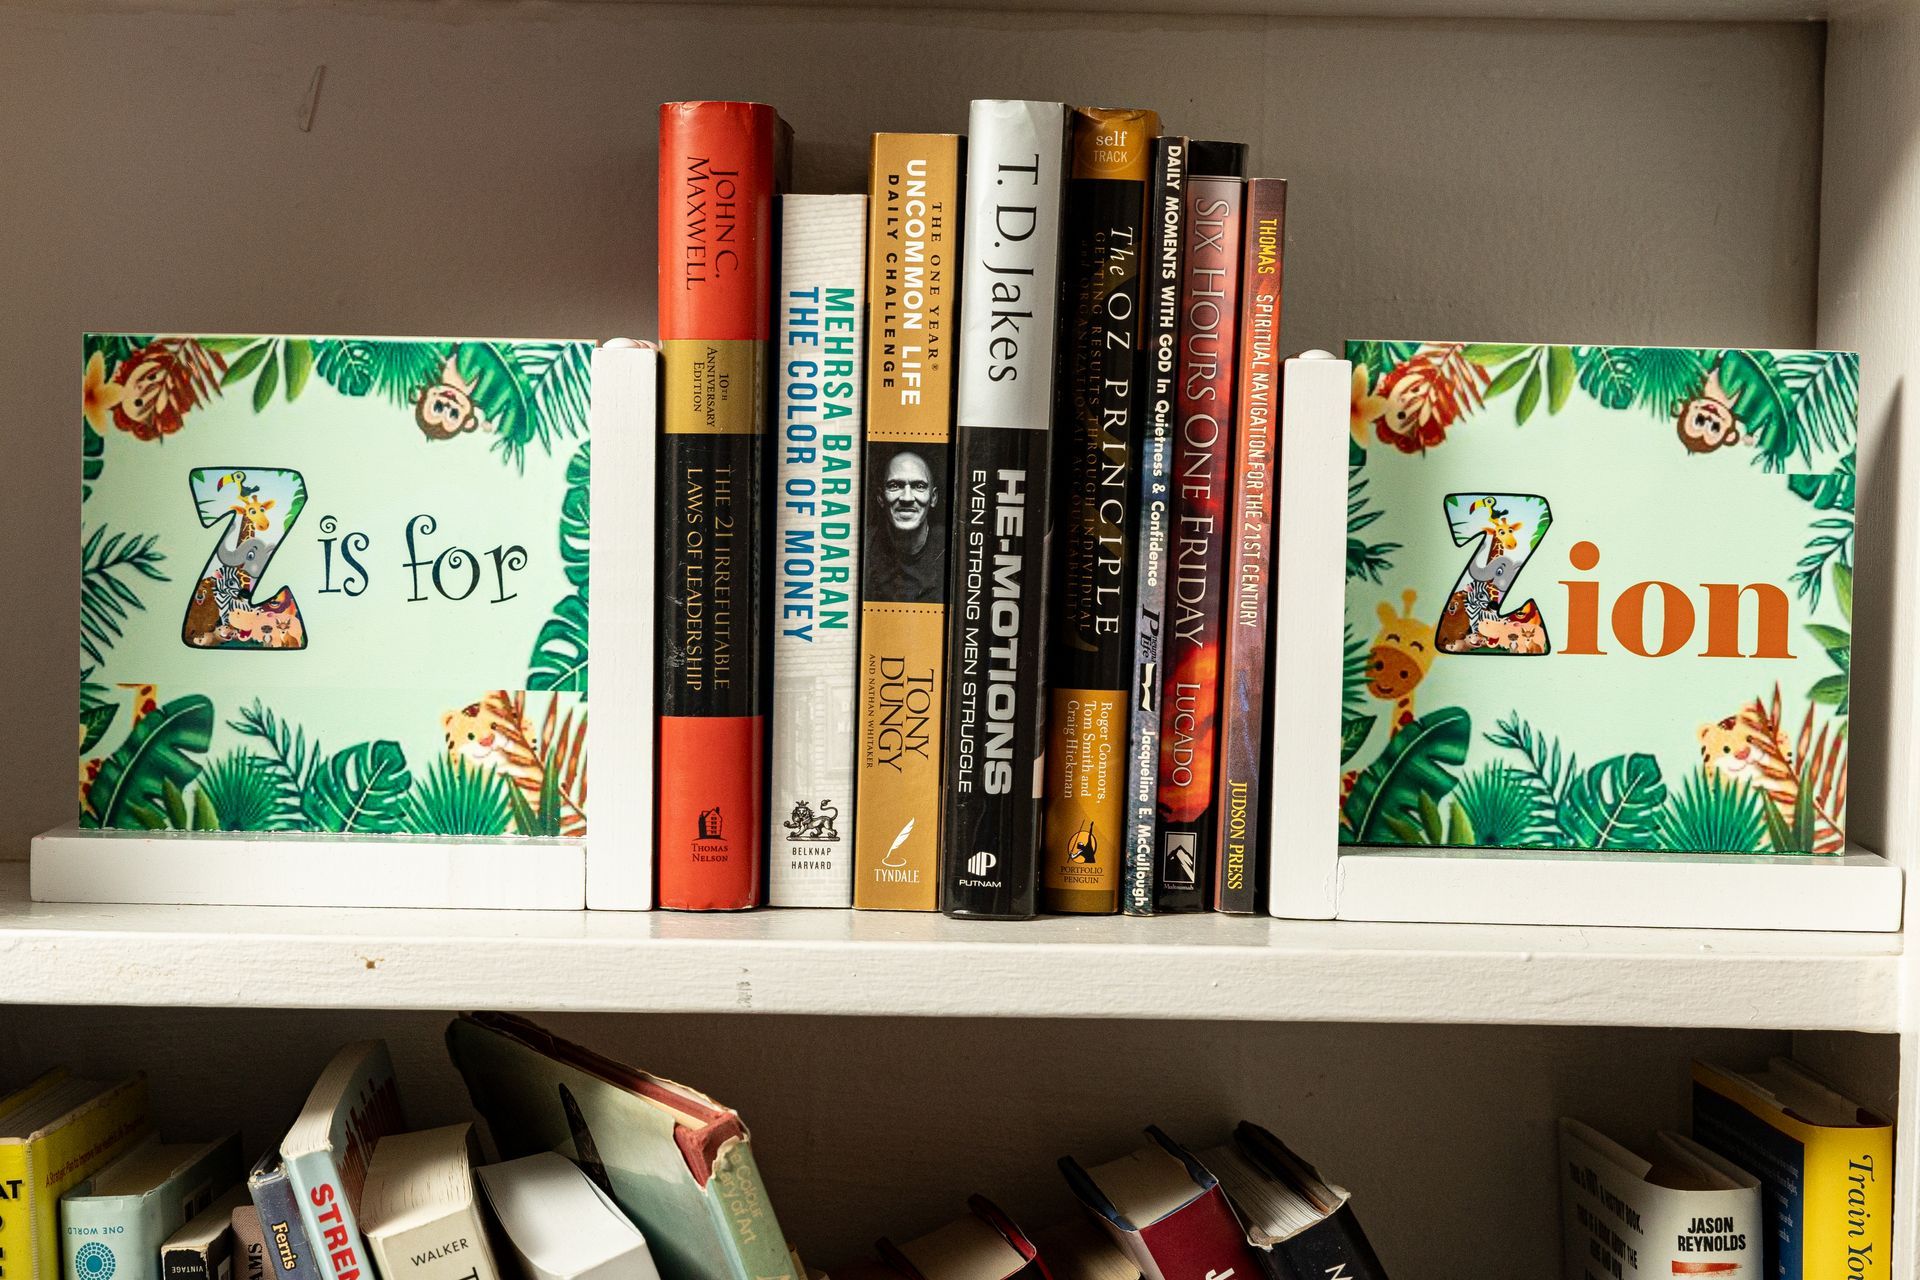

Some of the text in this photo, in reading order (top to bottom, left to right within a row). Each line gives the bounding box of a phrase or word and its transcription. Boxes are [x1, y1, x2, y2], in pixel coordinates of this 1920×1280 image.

[1094, 150, 1128, 163] TRACK
[1096, 131, 1128, 147] self
[686, 156, 710, 291] MAXWELL
[708, 168, 740, 280] JOHN C.
[931, 201, 943, 242] THE
[982, 153, 1040, 383] T. D. Jakes
[1257, 218, 1277, 275] THOMAS
[882, 174, 899, 389] DAILY CHALLENGE
[901, 159, 927, 406] UNCOMMON LIFE
[929, 254, 941, 296] ONE
[694, 362, 705, 412] EDITION
[707, 347, 718, 427] ANNIVERSARY
[1147, 145, 1182, 588] DAILY MOMENTS WITH GOD In Quietness & Confidence
[783, 286, 819, 643] THE COLOR OF MONEY
[819, 287, 855, 629] MEHRSA BARADARAN
[1080, 232, 1106, 631] GETTING RESULTS THROUGH INDIVIDUAL
[1095, 226, 1134, 635] The OZ PRINCIPLE
[1174, 198, 1230, 649] SIX HOURS ONE FRIDAY
[1239, 294, 1274, 628] SPIRITUAL NAVIGATION FOR THE 21ST CENTURY
[181, 466, 528, 650] Z is for
[686, 468, 704, 691] LAWS OF LEADERSHIP
[714, 464, 734, 690] THE 21 IRREFUTABLE
[1434, 492, 1798, 659] Zion
[958, 470, 986, 794] EVEN STRONG MEN STRUGGLE
[984, 468, 1027, 795] HE-MOTIONS
[866, 654, 876, 769] AND NATHAN WHITAKER
[878, 656, 905, 773] DUNGY
[905, 668, 935, 760] TONY
[1062, 700, 1079, 799] Craig Hickman
[1080, 700, 1097, 797] Tom Smith and
[1096, 702, 1113, 803] Roger Connors,
[1172, 682, 1200, 787] LUCADO
[691, 843, 729, 852] THOMAS
[692, 853, 729, 862] NELSON
[791, 860, 832, 870] HARVARD
[792, 847, 832, 856] BELKNAP
[1131, 728, 1156, 907] Jacqueline E. McCullough
[1227, 780, 1248, 891] JUDSON PRESS
[874, 869, 920, 883] TYNDALE
[959, 879, 1002, 888] PUTNAM
[1060, 866, 1103, 875] PORTFOLIO
[1064, 876, 1099, 884] PENGUIN
[67, 1226, 124, 1235] ONE WORLD
[731, 1200, 749, 1216] of
[736, 1218, 757, 1244] Art
[1677, 1234, 1746, 1252] REYNOLDS
[1687, 1217, 1734, 1234] JASON
[1848, 1154, 1875, 1238] Train
[171, 1266, 205, 1274] VINTAGE
[271, 1221, 298, 1270] Ferris
[411, 1238, 469, 1266] WALKER
